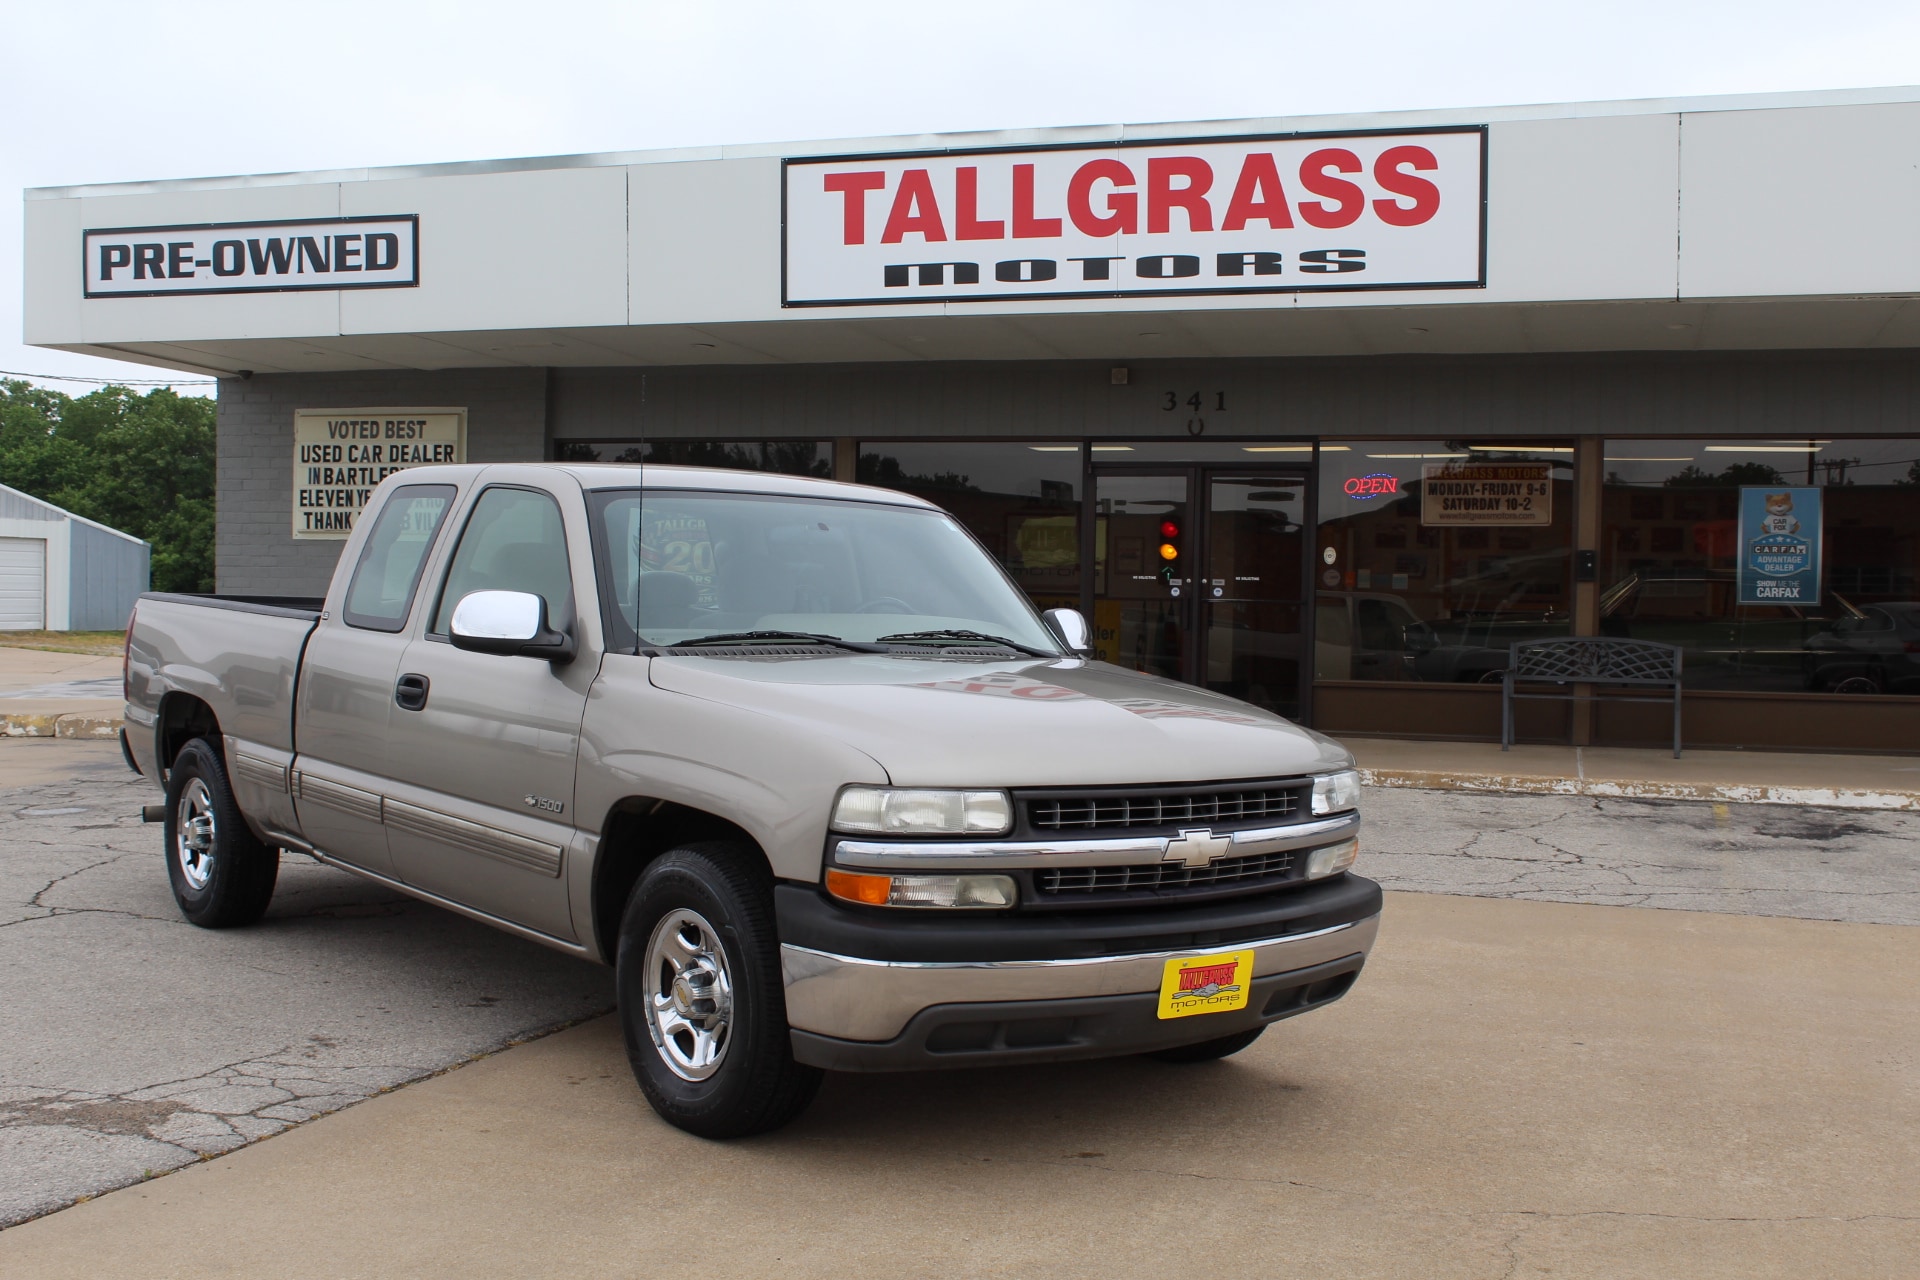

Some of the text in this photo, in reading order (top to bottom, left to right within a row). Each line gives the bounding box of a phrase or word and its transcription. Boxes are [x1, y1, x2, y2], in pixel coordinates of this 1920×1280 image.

[823, 145, 1441, 245] TALLGRASS
[99, 232, 399, 281] PRE-OWNED
[884, 249, 1366, 288] MOTORS
[1162, 390, 1227, 412] 341
[328, 420, 427, 440] VOTED BEST
[301, 444, 454, 463] USED CAR DEALER
[308, 467, 408, 485] IN BARTLE
[1498, 468, 1546, 479] MOTORS
[1344, 478, 1398, 494] OPEN
[1428, 483, 1547, 496] MONDAY-FRIDAY 9-6
[299, 489, 354, 507] ELEVEN
[1443, 497, 1532, 511] SATURDAY 10-2
[303, 511, 352, 530] THANK
[1754, 545, 1806, 554] CARFAX
[1756, 587, 1800, 598] CARFAX
[537, 797, 563, 813] 1500
[1179, 962, 1239, 991] TALLGRASS
[1170, 994, 1240, 1009] MOTORS
